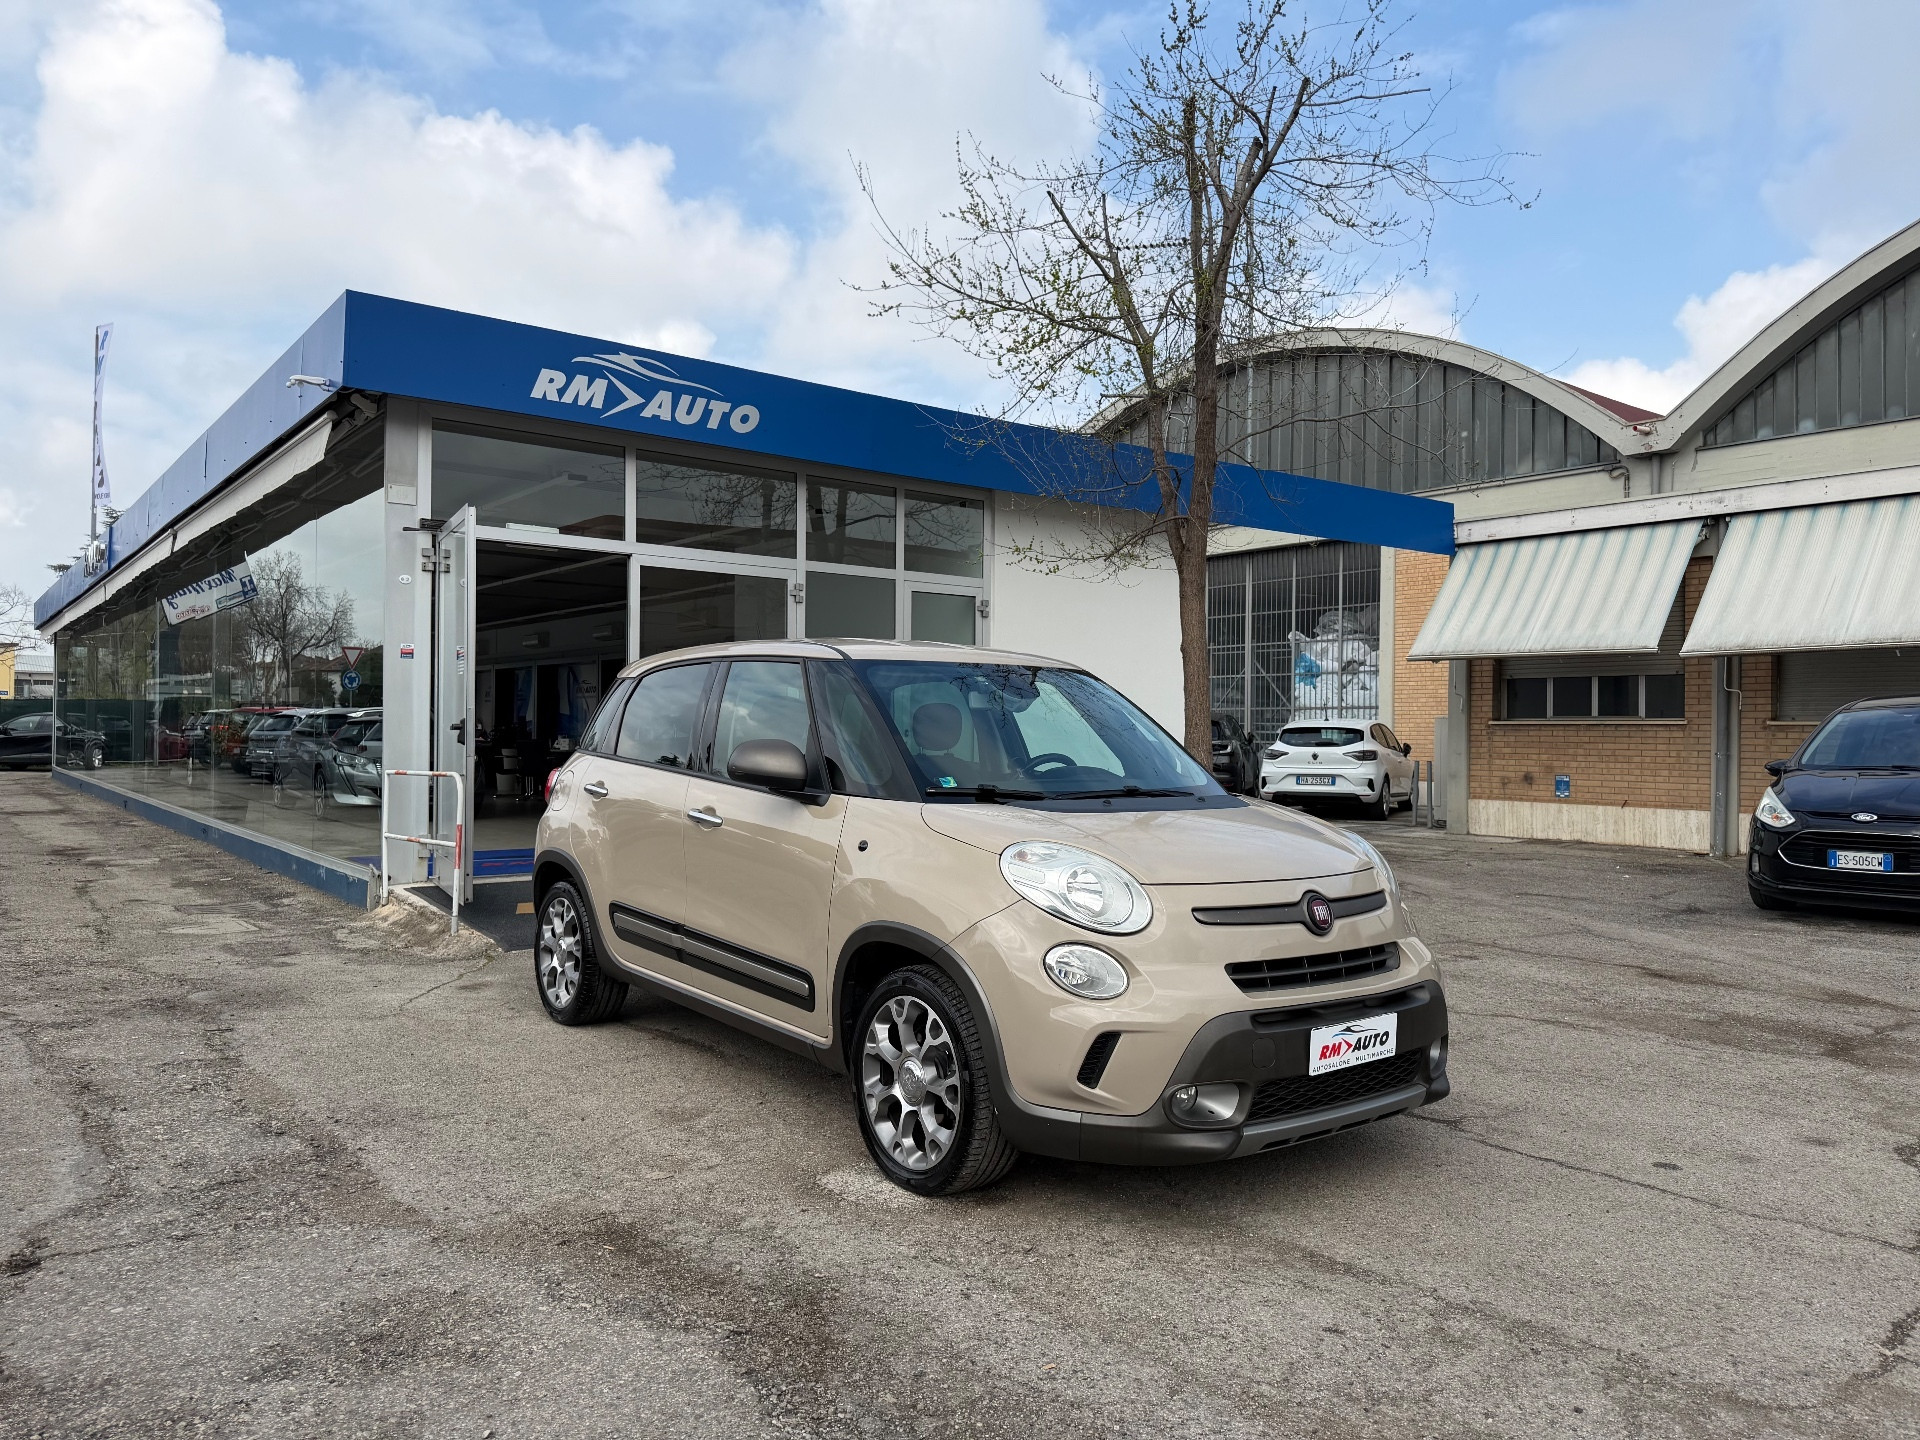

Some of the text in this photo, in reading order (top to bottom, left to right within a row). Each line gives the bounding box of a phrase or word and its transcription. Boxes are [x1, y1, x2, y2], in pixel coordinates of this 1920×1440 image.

[530, 368, 760, 433] RM AUTO
[1313, 905, 1330, 921] FIAT
[1319, 1031, 1390, 1060] RM AUTO
[1312, 1048, 1394, 1073] AUTOSALONE MULTIMARCHE
